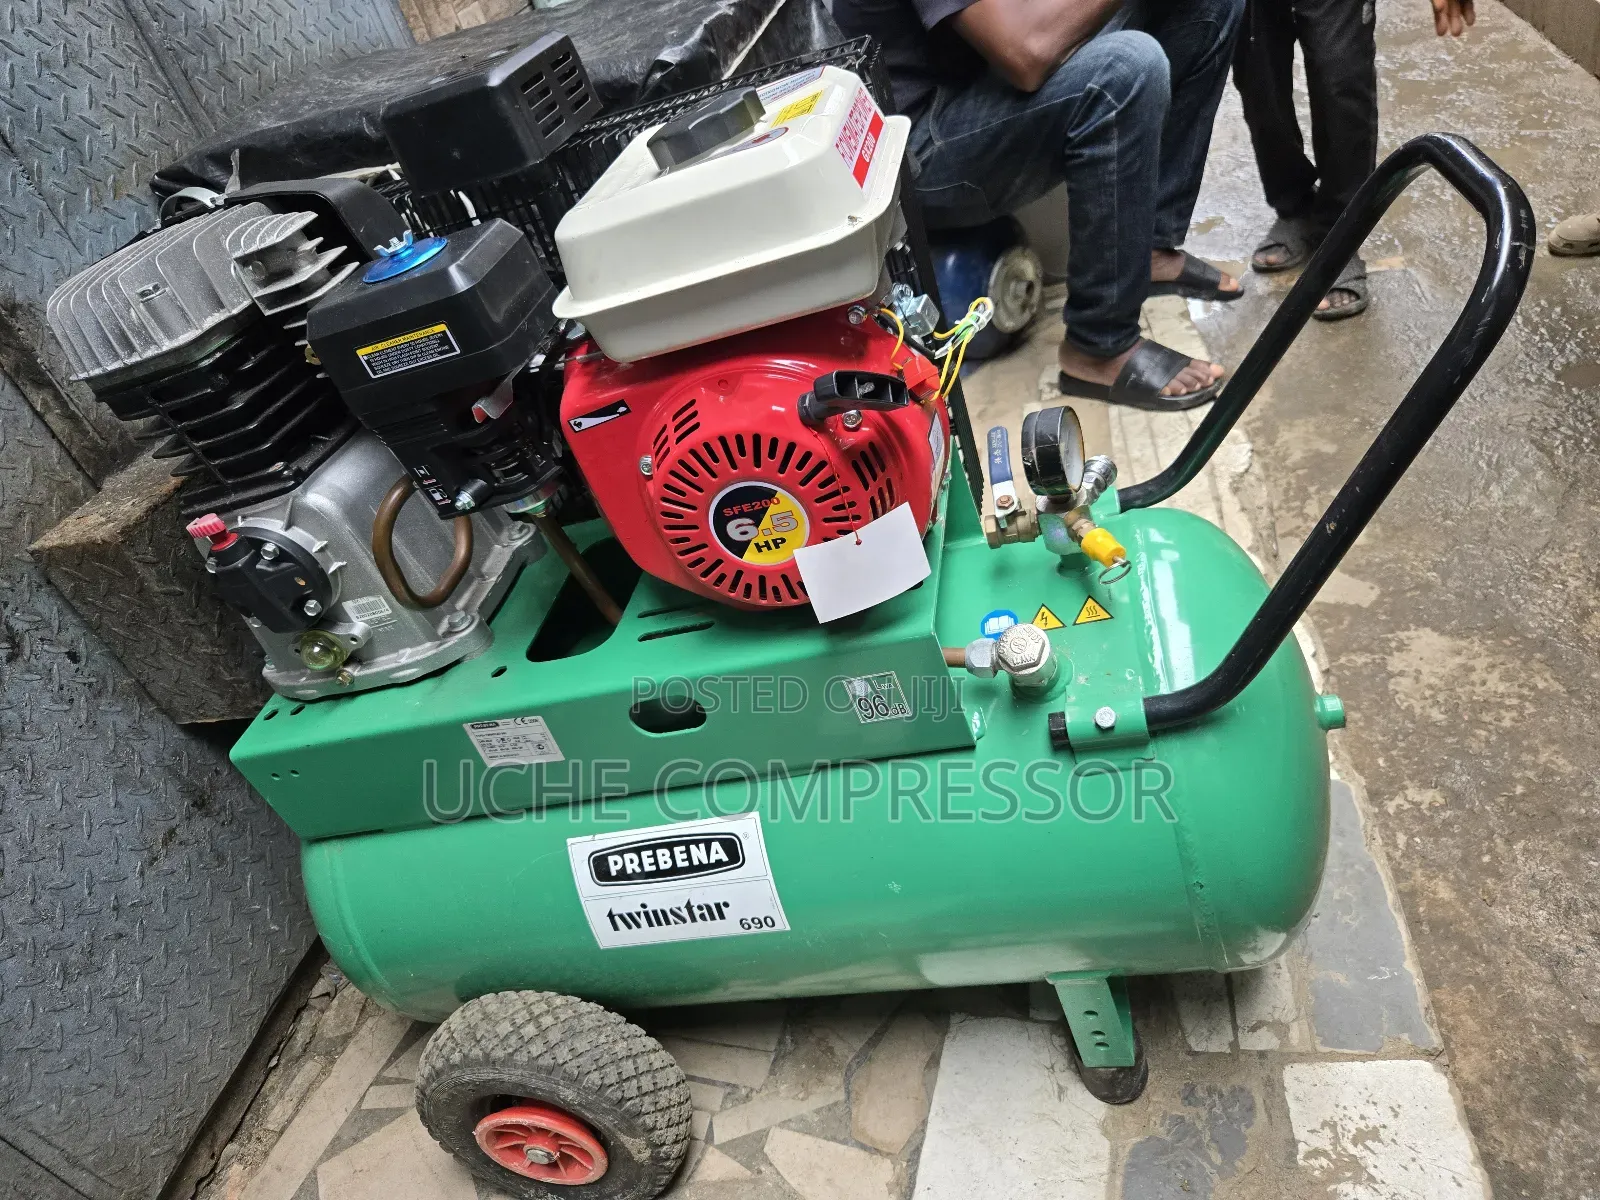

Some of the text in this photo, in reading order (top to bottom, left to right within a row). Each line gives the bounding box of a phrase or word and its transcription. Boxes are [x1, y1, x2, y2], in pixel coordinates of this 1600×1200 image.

[861, 132, 877, 163] GX200
[722, 497, 780, 517] SFE200
[726, 511, 799, 542] 6.5
[754, 537, 787, 553] HP
[857, 694, 907, 720] 96 dB
[607, 841, 729, 877] PREBENA
[606, 898, 776, 932] twinstar 690
